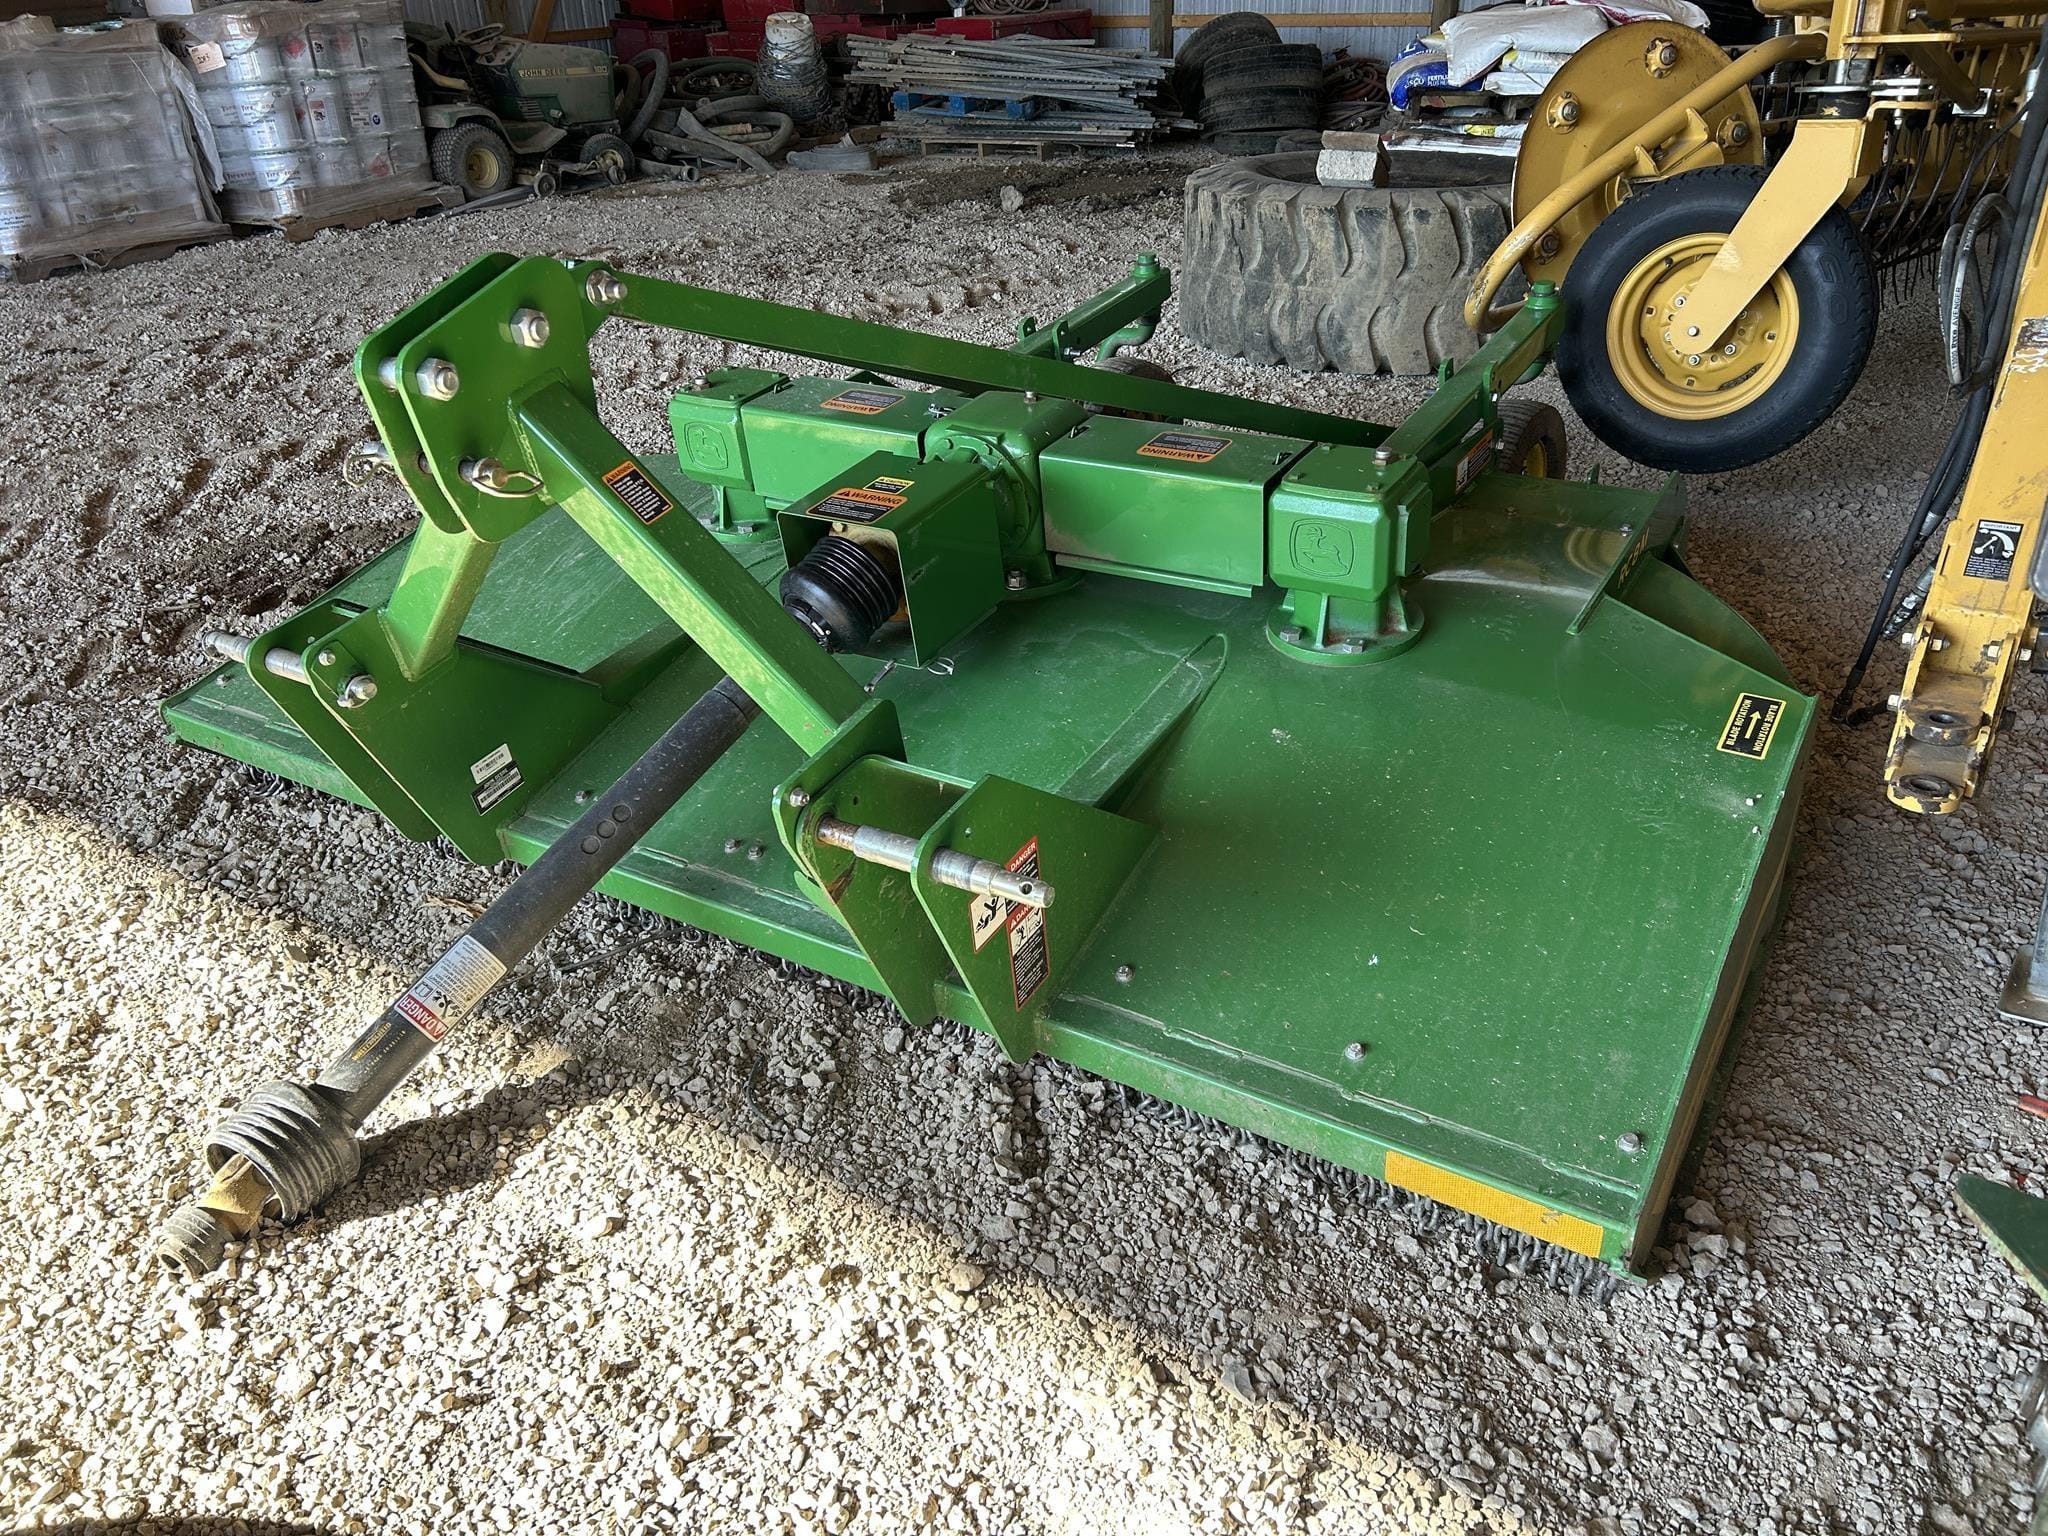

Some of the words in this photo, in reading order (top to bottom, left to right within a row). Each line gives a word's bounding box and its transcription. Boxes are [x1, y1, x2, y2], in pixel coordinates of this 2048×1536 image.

[522, 69, 541, 77] JOHN
[1952, 287, 1962, 327] AVENGER
[1142, 447, 1195, 459] WARNING
[851, 491, 903, 505] WARNING
[1726, 726, 1741, 746] BLADE
[1735, 699, 1752, 727] ROTATION
[1765, 704, 1779, 723] BLADE
[1753, 721, 1771, 752] ROTATION
[1010, 842, 1037, 873] DANGER
[400, 996, 434, 1029] DANGER
